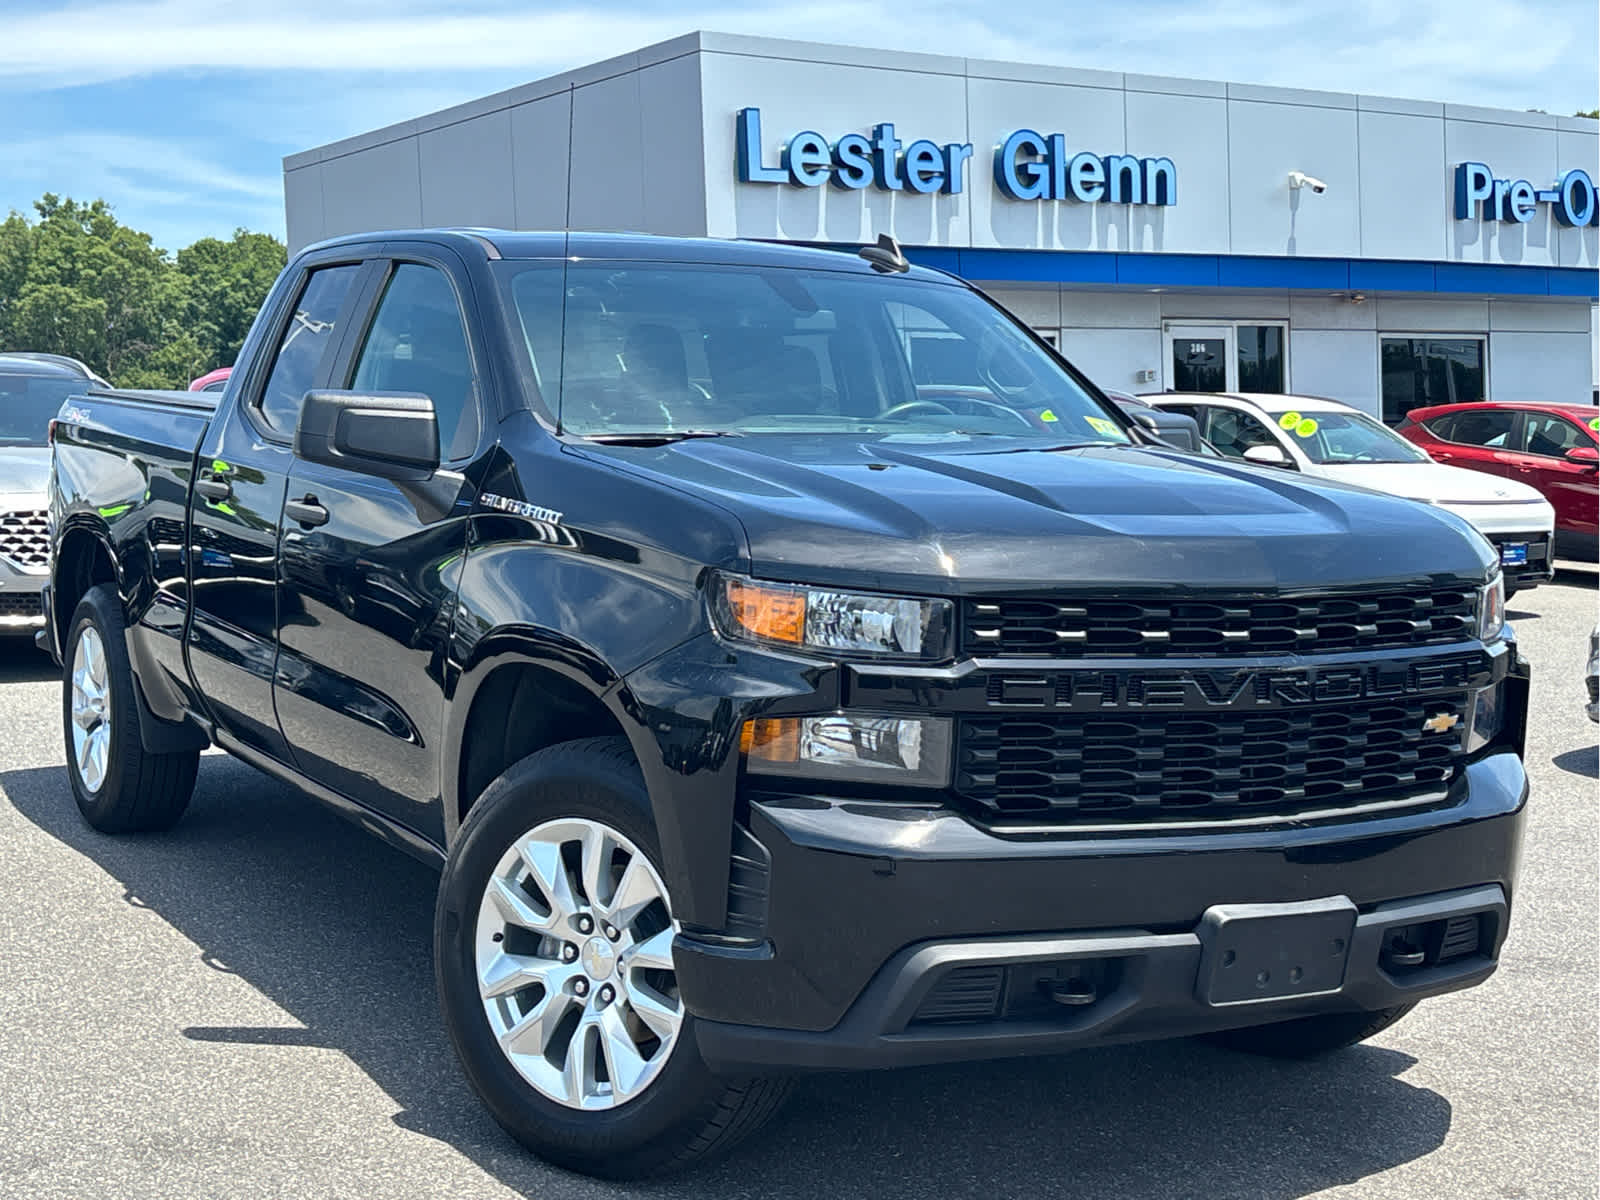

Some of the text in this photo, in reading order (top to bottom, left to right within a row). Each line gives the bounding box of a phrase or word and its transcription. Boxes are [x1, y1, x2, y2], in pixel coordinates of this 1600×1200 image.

[736, 107, 1177, 206] Lester Glenn
[1455, 162, 1599, 228] Pre-O
[480, 492, 563, 525] SILVERADO
